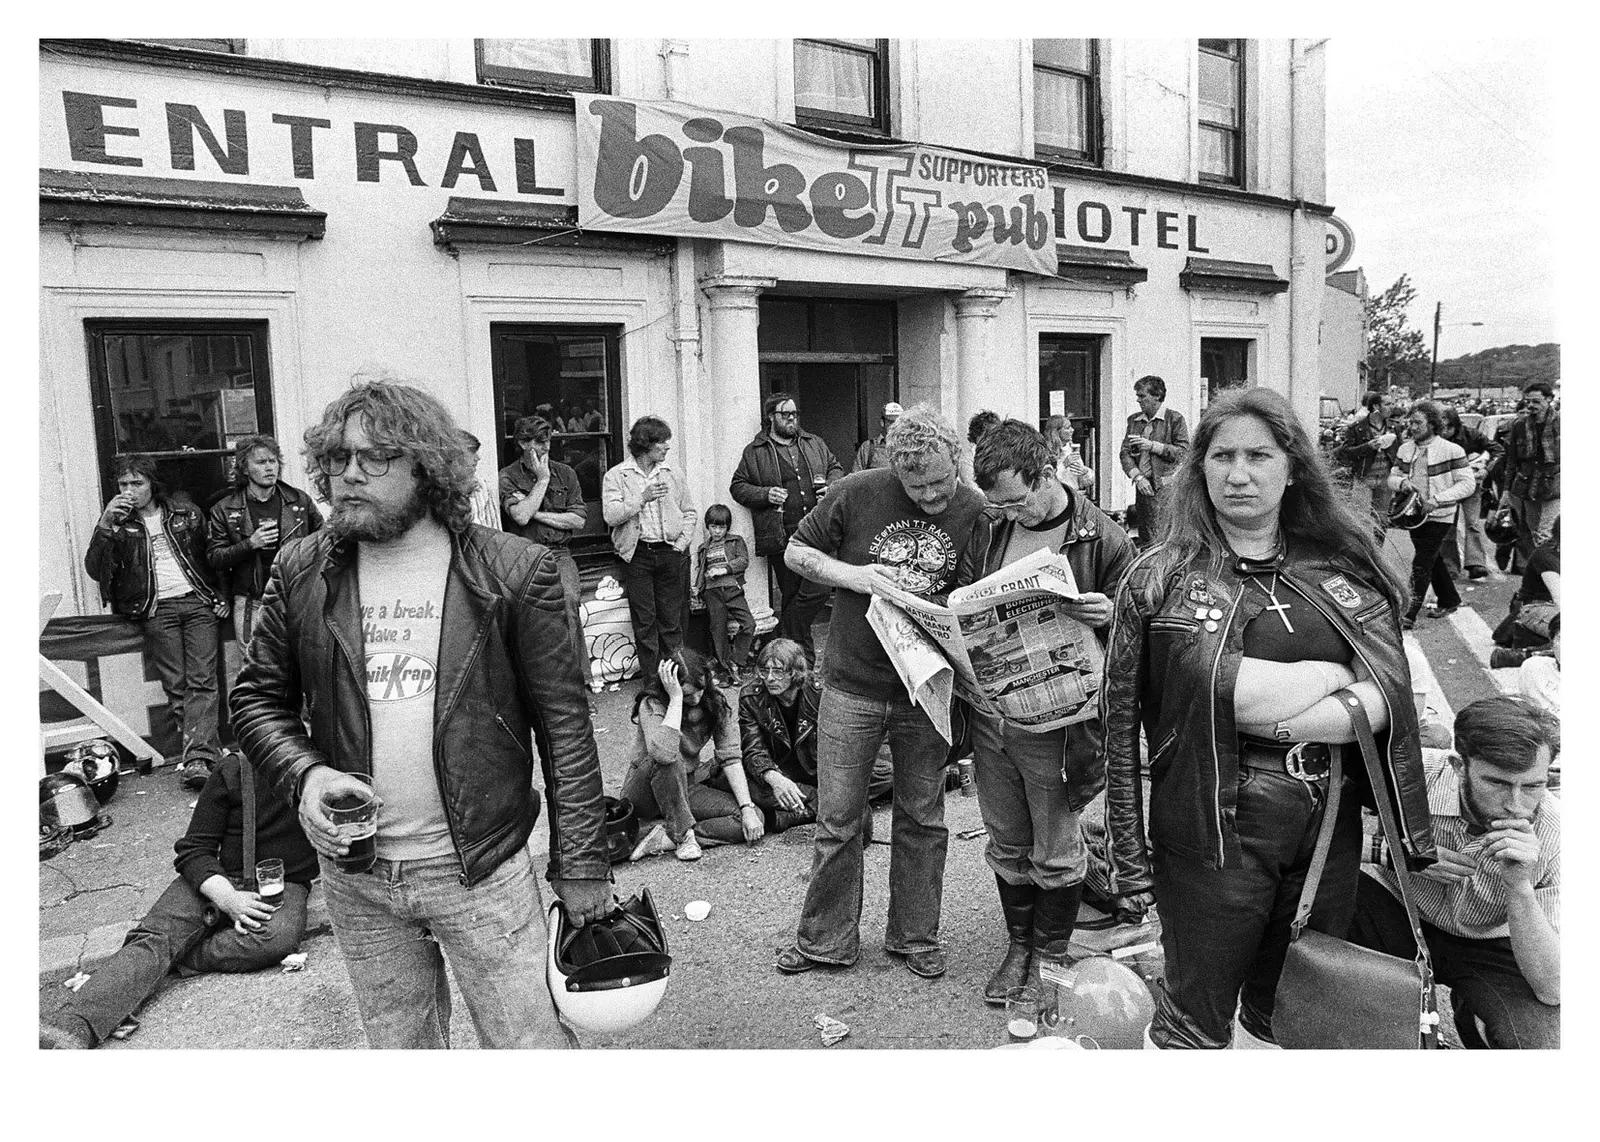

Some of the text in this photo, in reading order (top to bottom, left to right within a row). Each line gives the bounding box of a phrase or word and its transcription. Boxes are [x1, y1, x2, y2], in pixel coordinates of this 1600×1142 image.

[62, 90, 565, 196] ENTRAL
[588, 99, 876, 239] bike
[948, 194, 1048, 253] pub
[918, 153, 1045, 189] SUPPORTERS
[869, 534, 883, 555] ISLE
[885, 520, 910, 533] MAN
[928, 524, 953, 549] RACES
[948, 549, 957, 571] 1979
[378, 605, 387, 619] a
[363, 622, 412, 643] Have a
[365, 654, 432, 699] wikKrap
[1012, 665, 1060, 688] MANCHESTER
